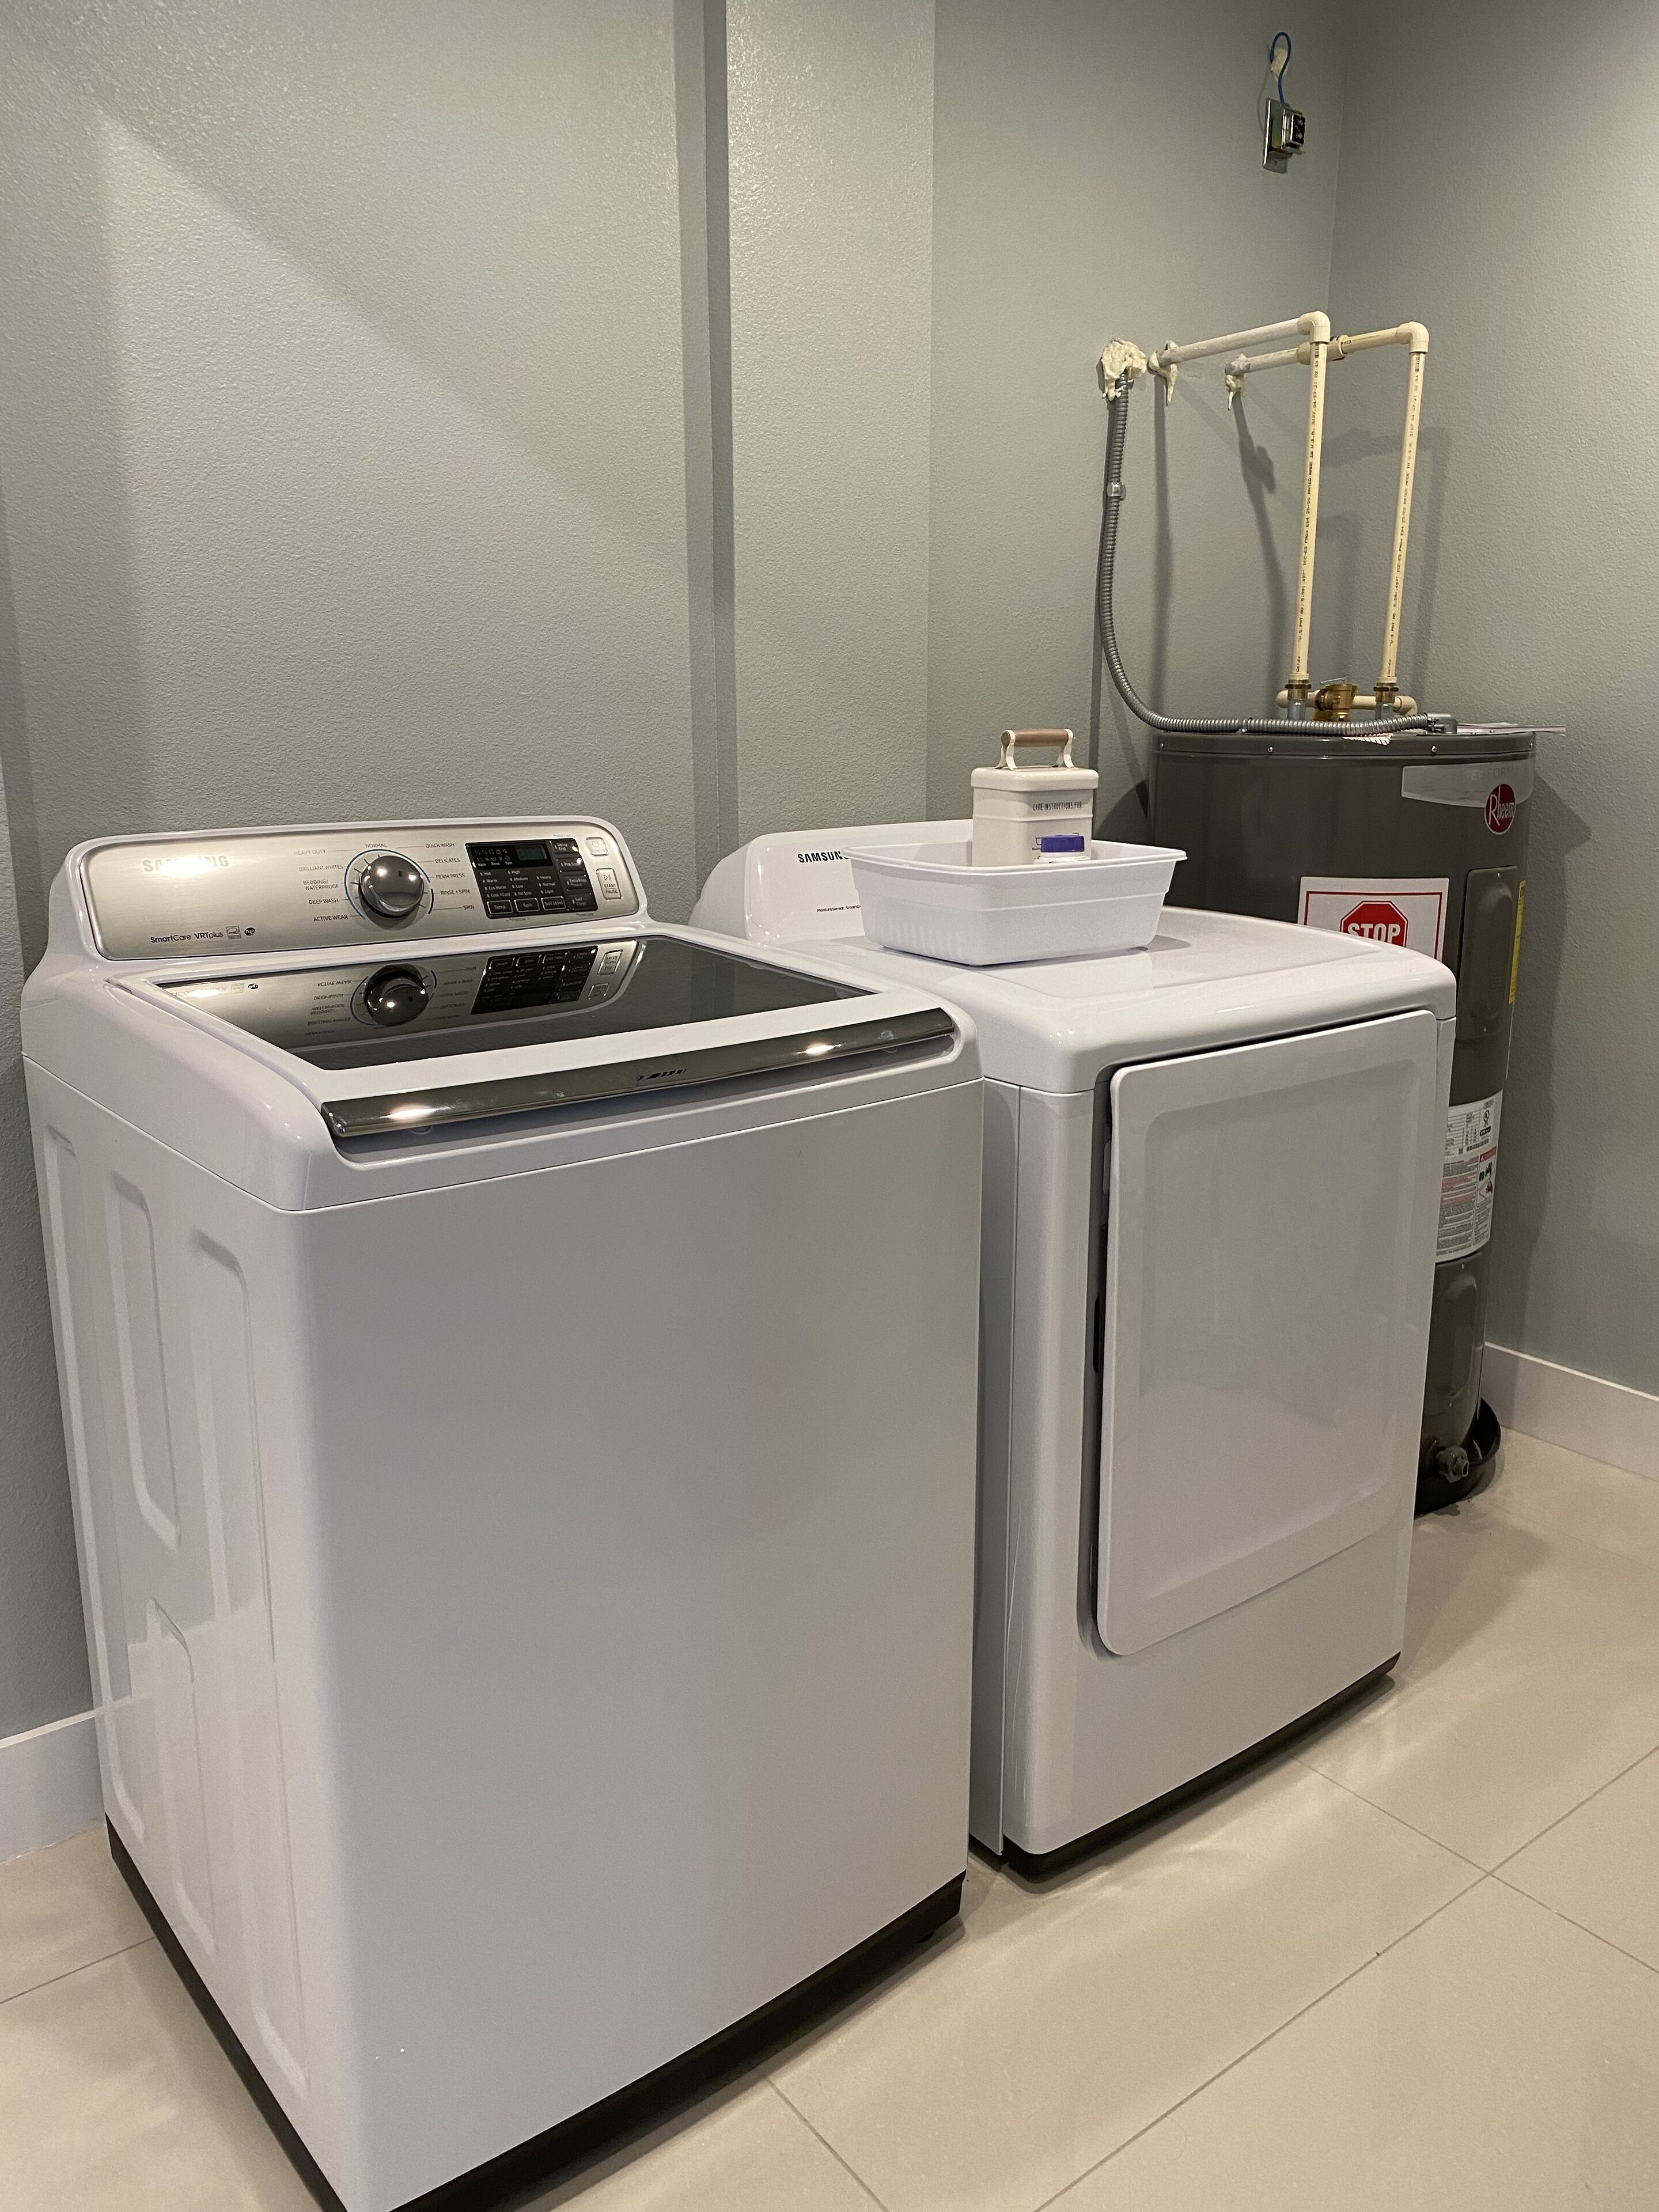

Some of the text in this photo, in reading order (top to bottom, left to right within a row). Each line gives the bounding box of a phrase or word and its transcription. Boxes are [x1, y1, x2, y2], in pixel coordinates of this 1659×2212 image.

[1032, 801, 1083, 811] CARE INSTRUCTIONS FOR
[1488, 785, 1515, 827] Rheem
[797, 851, 850, 863] SAMSUN
[150, 934, 191, 943] SmartCare
[194, 931, 224, 940] VRTplus
[1348, 923, 1401, 944] STOP
